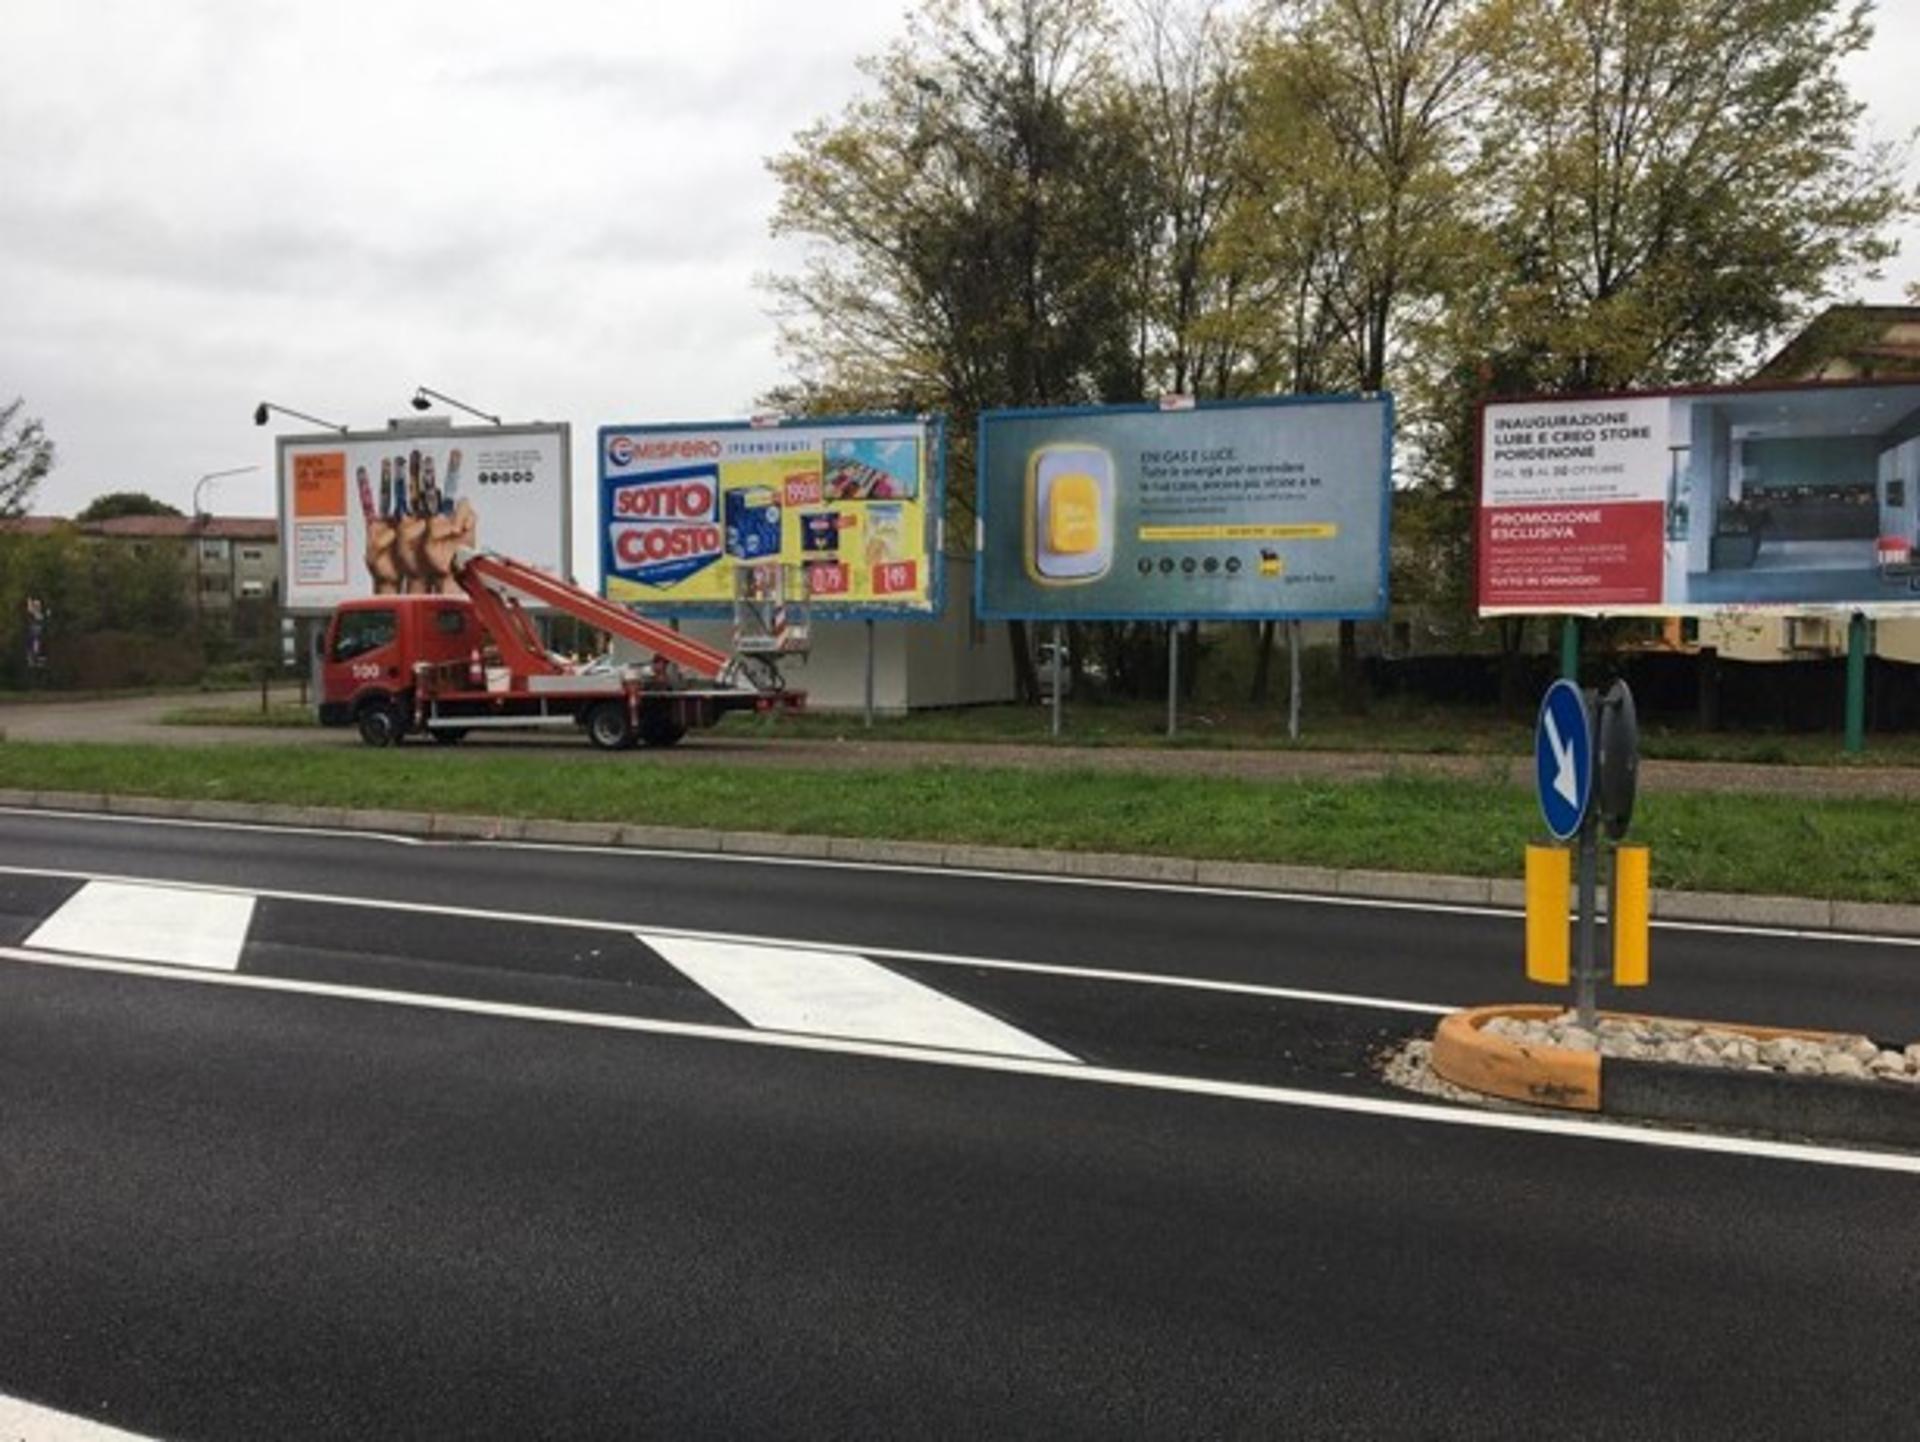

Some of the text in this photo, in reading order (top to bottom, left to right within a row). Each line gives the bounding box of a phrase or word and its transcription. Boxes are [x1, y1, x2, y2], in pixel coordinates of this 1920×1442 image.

[1538, 432, 1547, 444] E
[1600, 426, 1651, 441] STORE
[616, 482, 712, 516] SOTTO
[616, 526, 720, 563] COSTO
